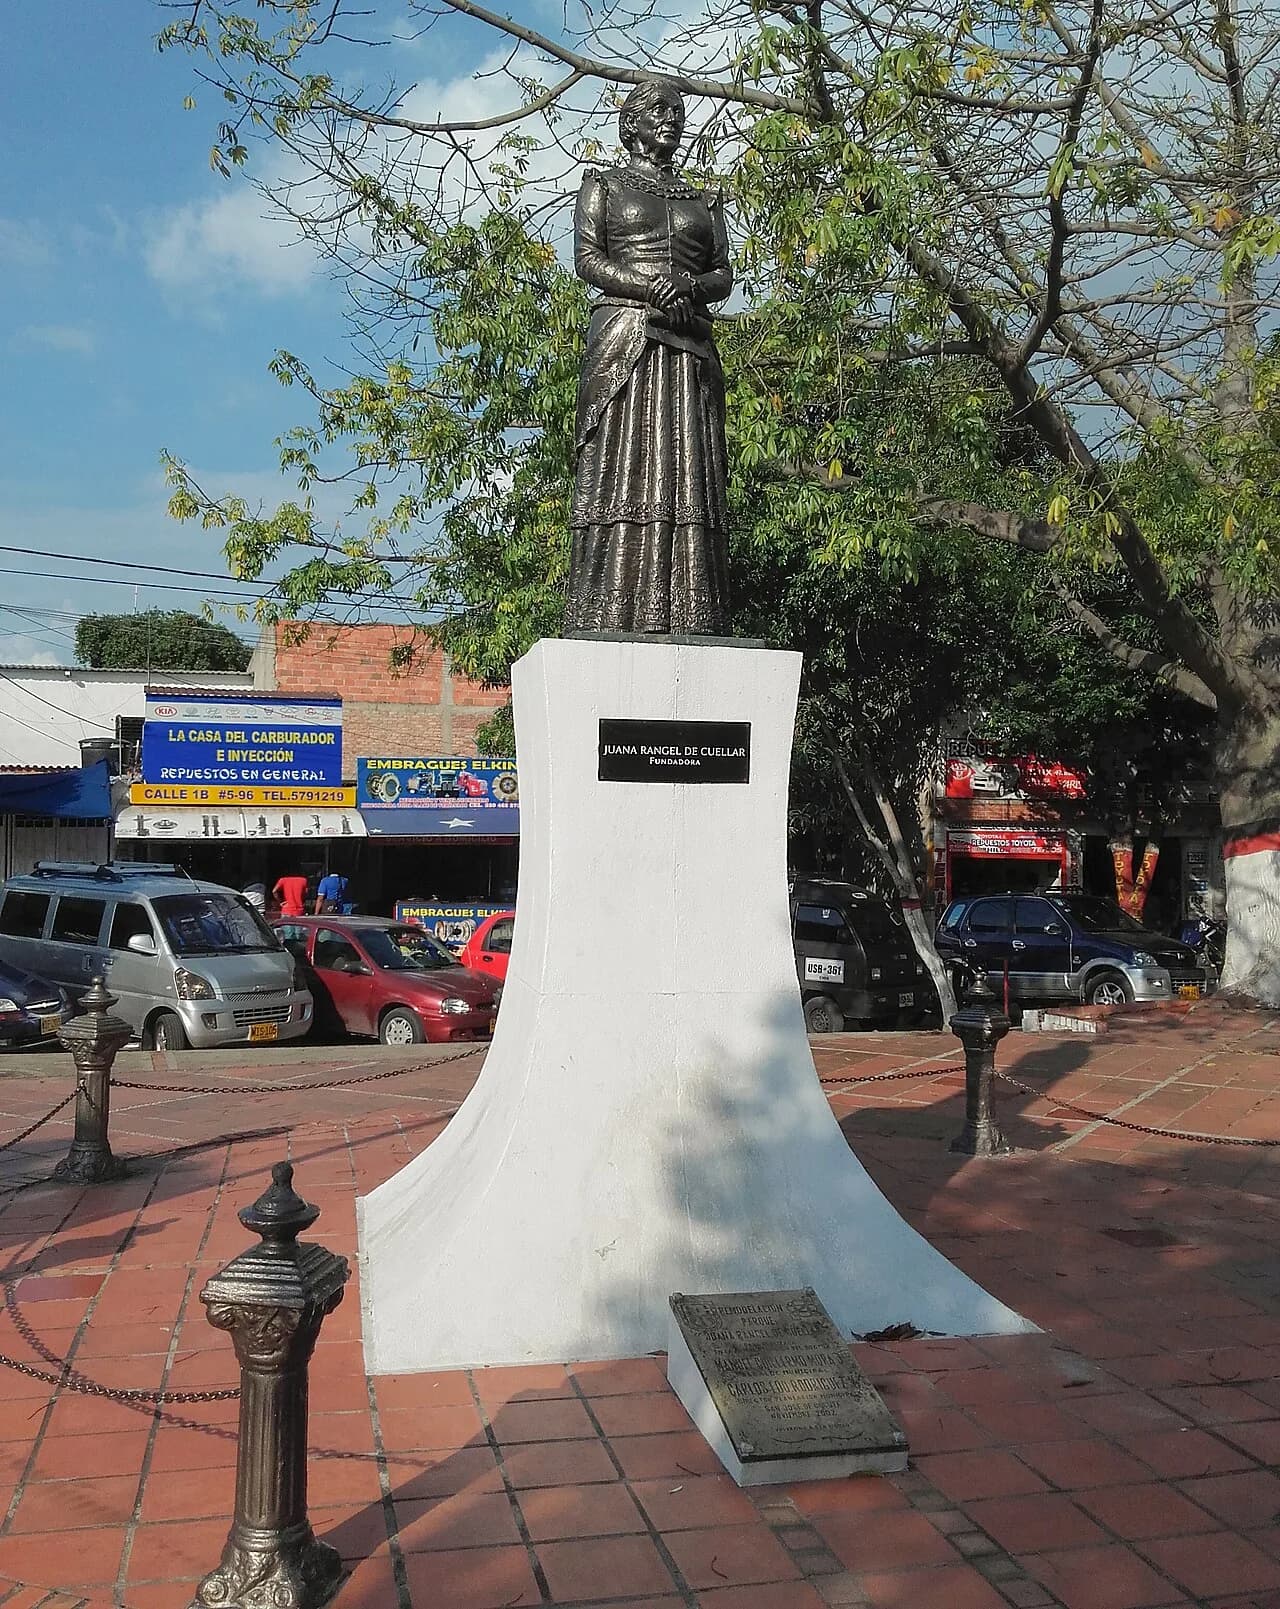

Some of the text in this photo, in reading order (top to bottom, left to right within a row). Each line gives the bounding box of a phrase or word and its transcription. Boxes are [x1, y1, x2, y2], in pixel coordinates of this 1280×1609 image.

[168, 730, 335, 744] LA CASA DEL CARBURADOR
[216, 747, 294, 762] E INYECCIÓN
[602, 745, 746, 757] JUANA RANGEL DE CUELLAR
[367, 760, 518, 770] EMBRAGUES ELKIN
[160, 767, 326, 781] REPUESTOS EN GENERAL
[144, 789, 188, 799] CALLE
[193, 789, 209, 799] 1B
[218, 790, 254, 800] #5-96
[971, 839, 1010, 847] REPUESTOS
[402, 908, 474, 917] EMBRAGUES
